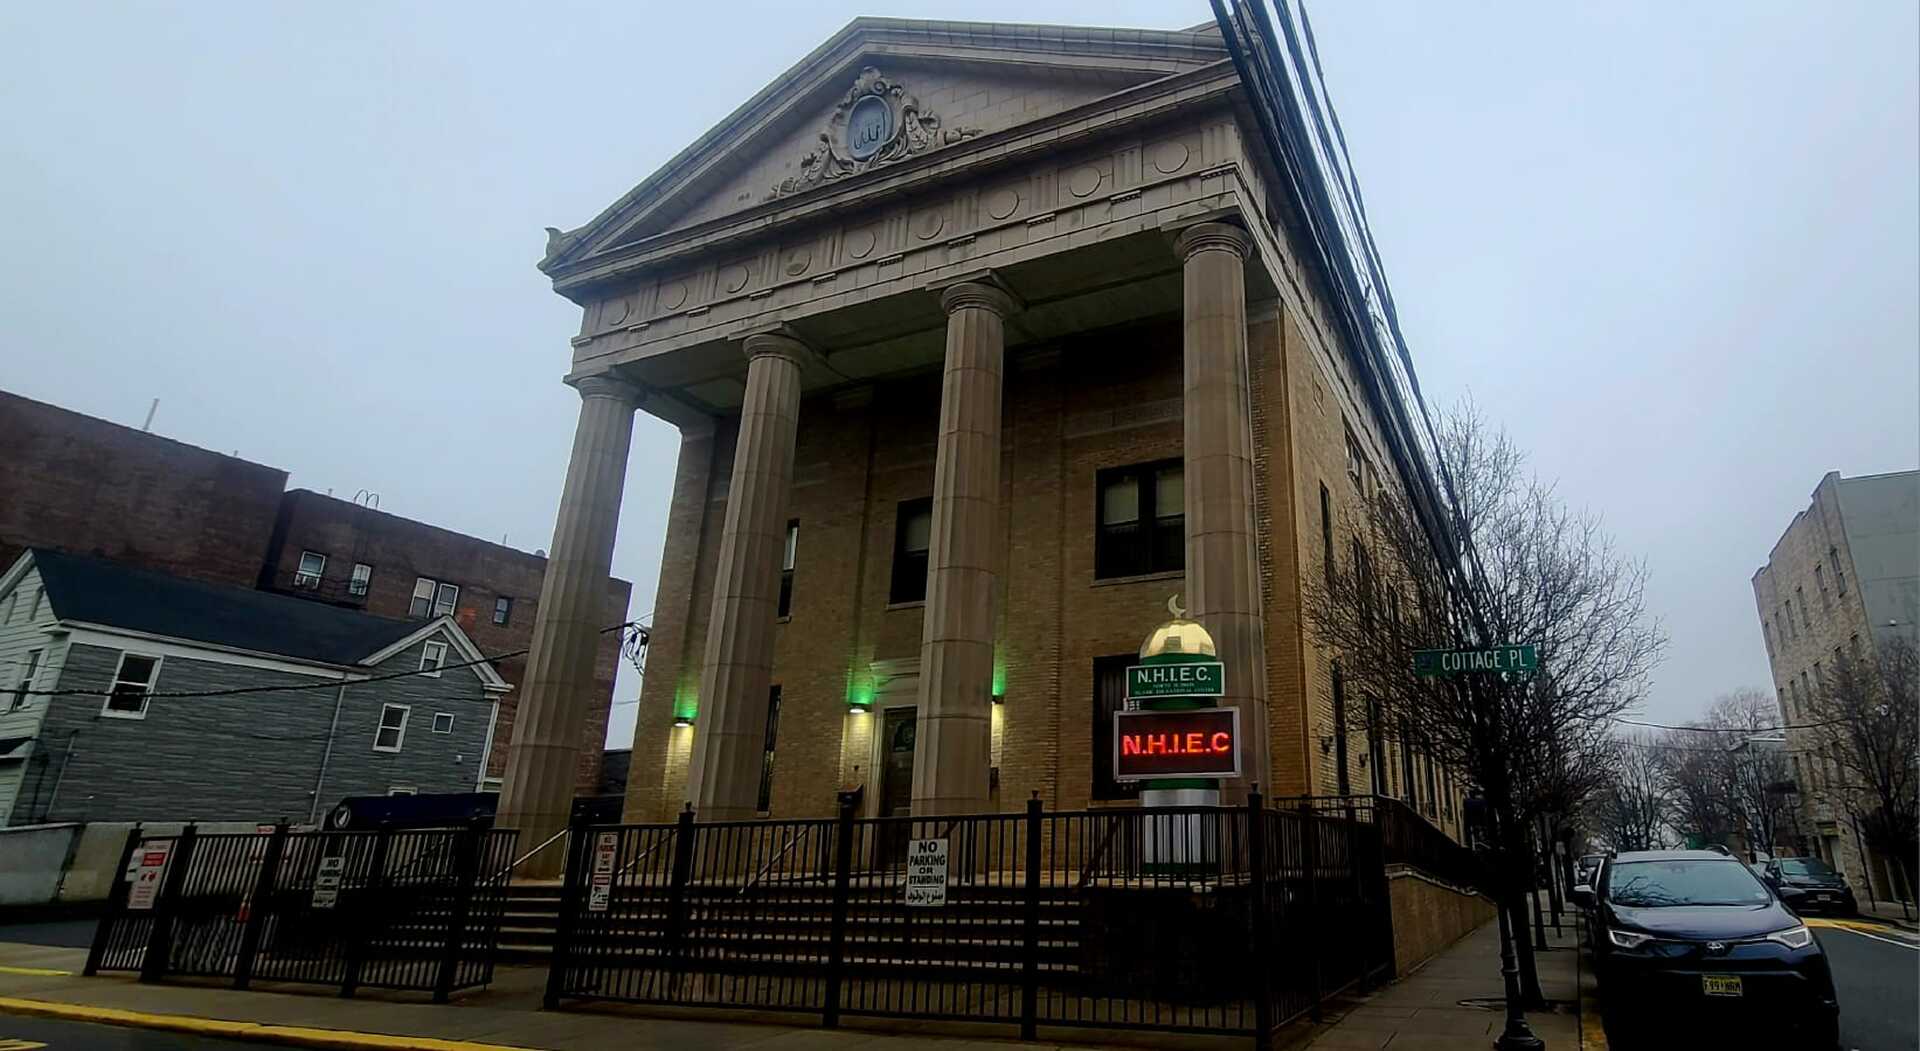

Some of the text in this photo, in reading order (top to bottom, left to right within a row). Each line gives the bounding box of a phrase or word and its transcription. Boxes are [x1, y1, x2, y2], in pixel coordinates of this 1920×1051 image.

[1442, 649, 1528, 671] COTTAGE PL
[1137, 667, 1212, 684] N.H.I.E.C.
[1122, 732, 1230, 756] N.H.I.E.C
[918, 842, 938, 854] NO
[909, 854, 946, 867] PARKING
[919, 867, 933, 875] OR
[908, 875, 945, 886] STANDING
